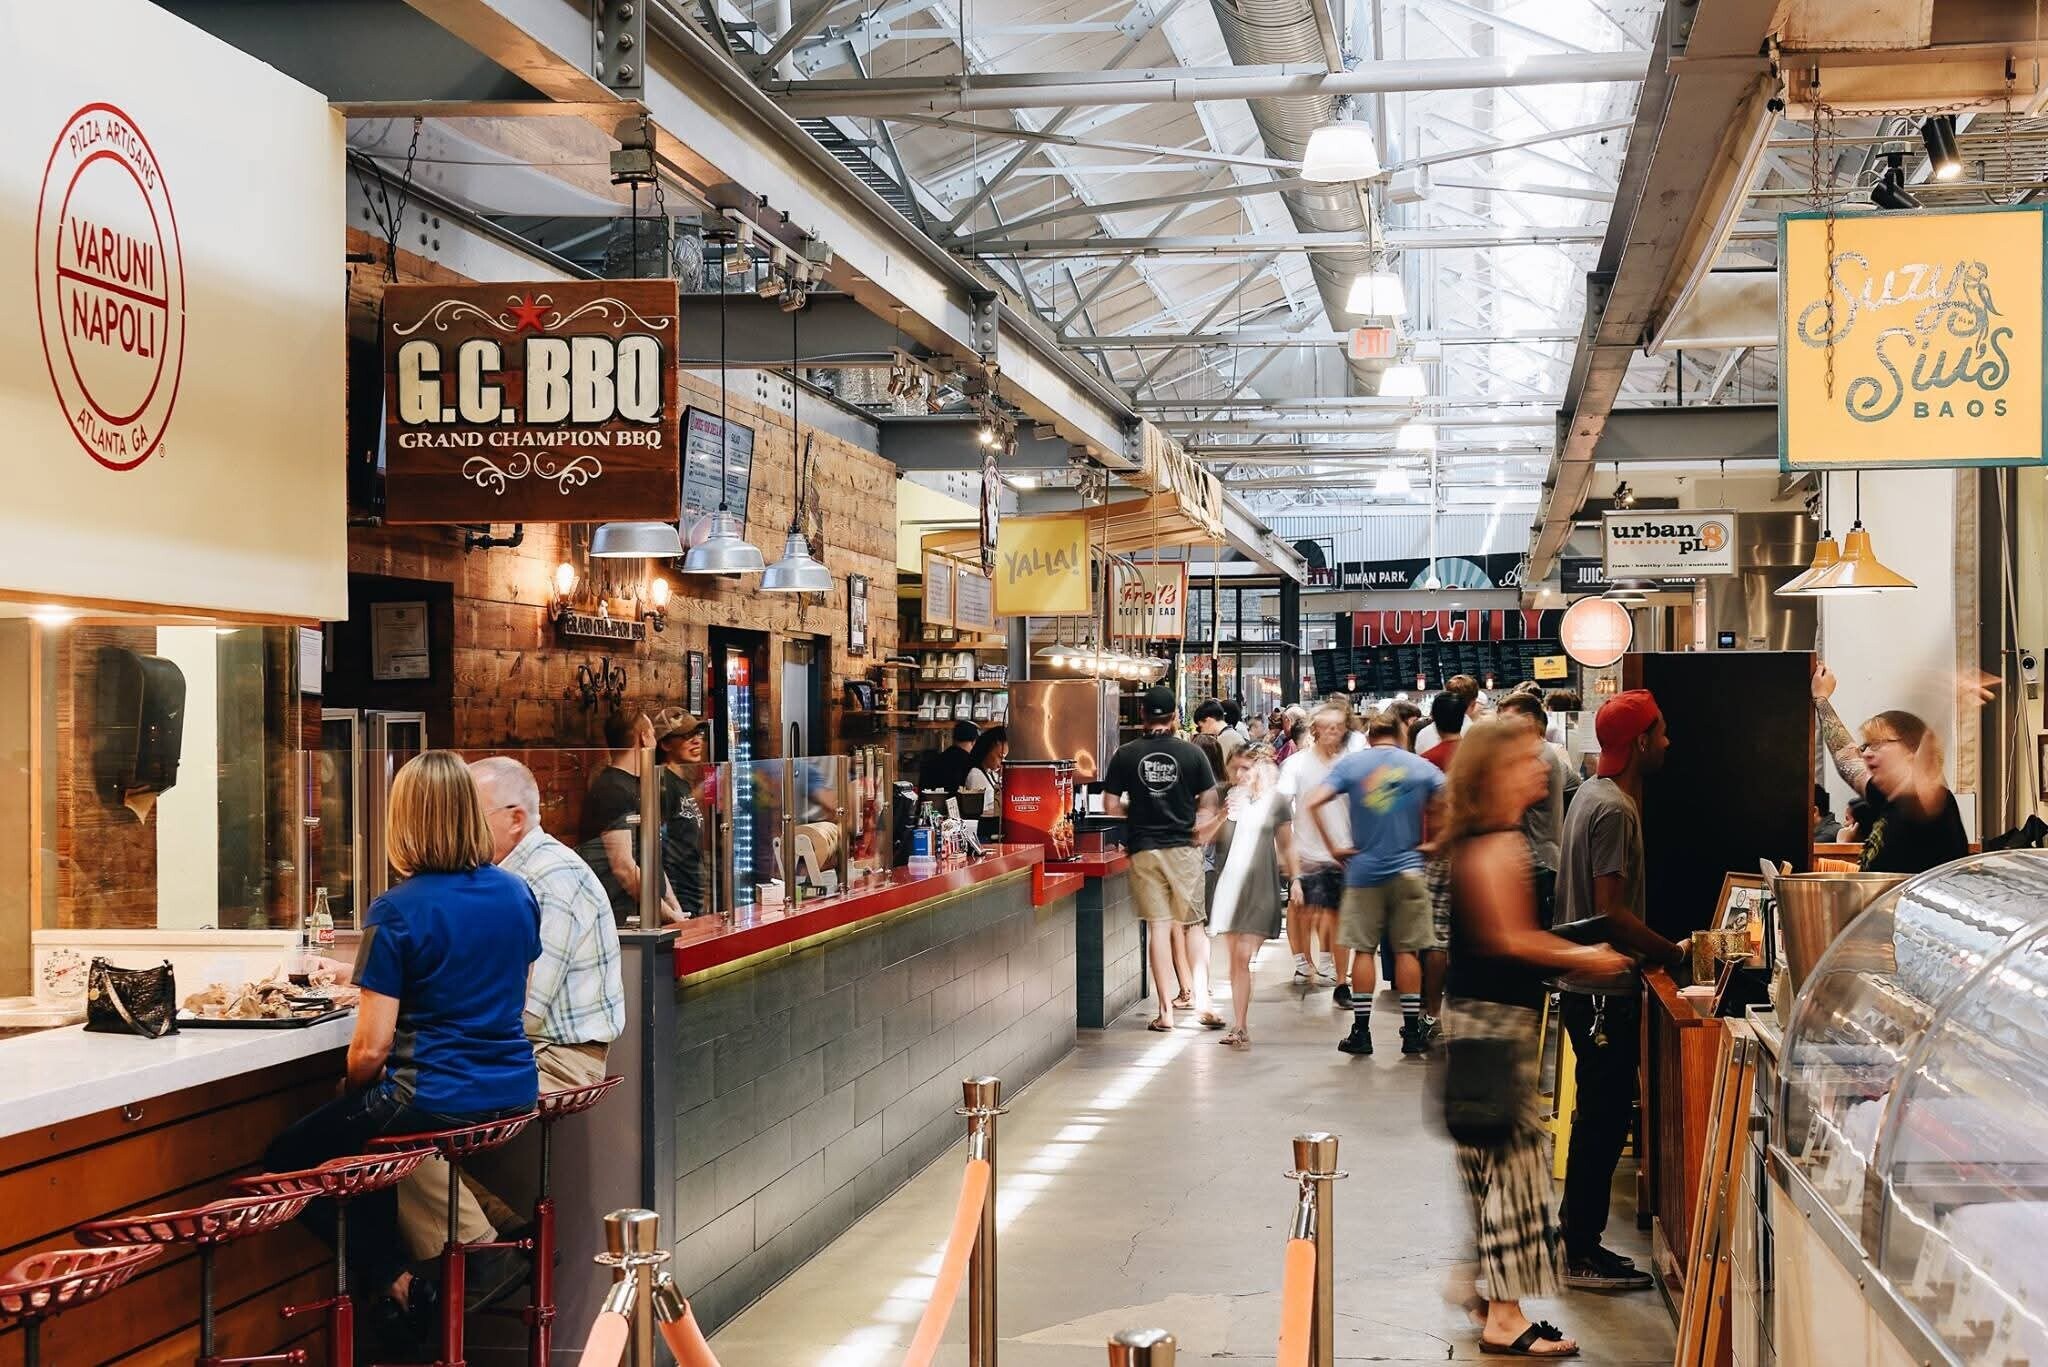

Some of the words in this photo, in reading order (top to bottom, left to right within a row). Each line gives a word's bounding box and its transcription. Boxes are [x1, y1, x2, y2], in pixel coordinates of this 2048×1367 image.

[69, 119, 102, 158] PIZZA
[106, 119, 156, 190] ARTISANS
[71, 216, 154, 291] VARUNI
[1797, 250, 1972, 348] Suzy
[73, 287, 154, 359] NAPOLI
[526, 336, 660, 424] BBQ
[77, 407, 127, 456] ATLANTA
[131, 424, 149, 451] GA
[1913, 398, 2008, 420] BAOS
[399, 433, 484, 448] GRAND
[488, 430, 610, 447] CHAMPION
[615, 430, 662, 449] BBQ
[1612, 522, 1695, 538] urban
[1004, 542, 1081, 585] YALLA!
[1345, 572, 1377, 585] INMAN
[1379, 570, 1409, 584] PARK,
[1011, 794, 1041, 803] Luzianne
